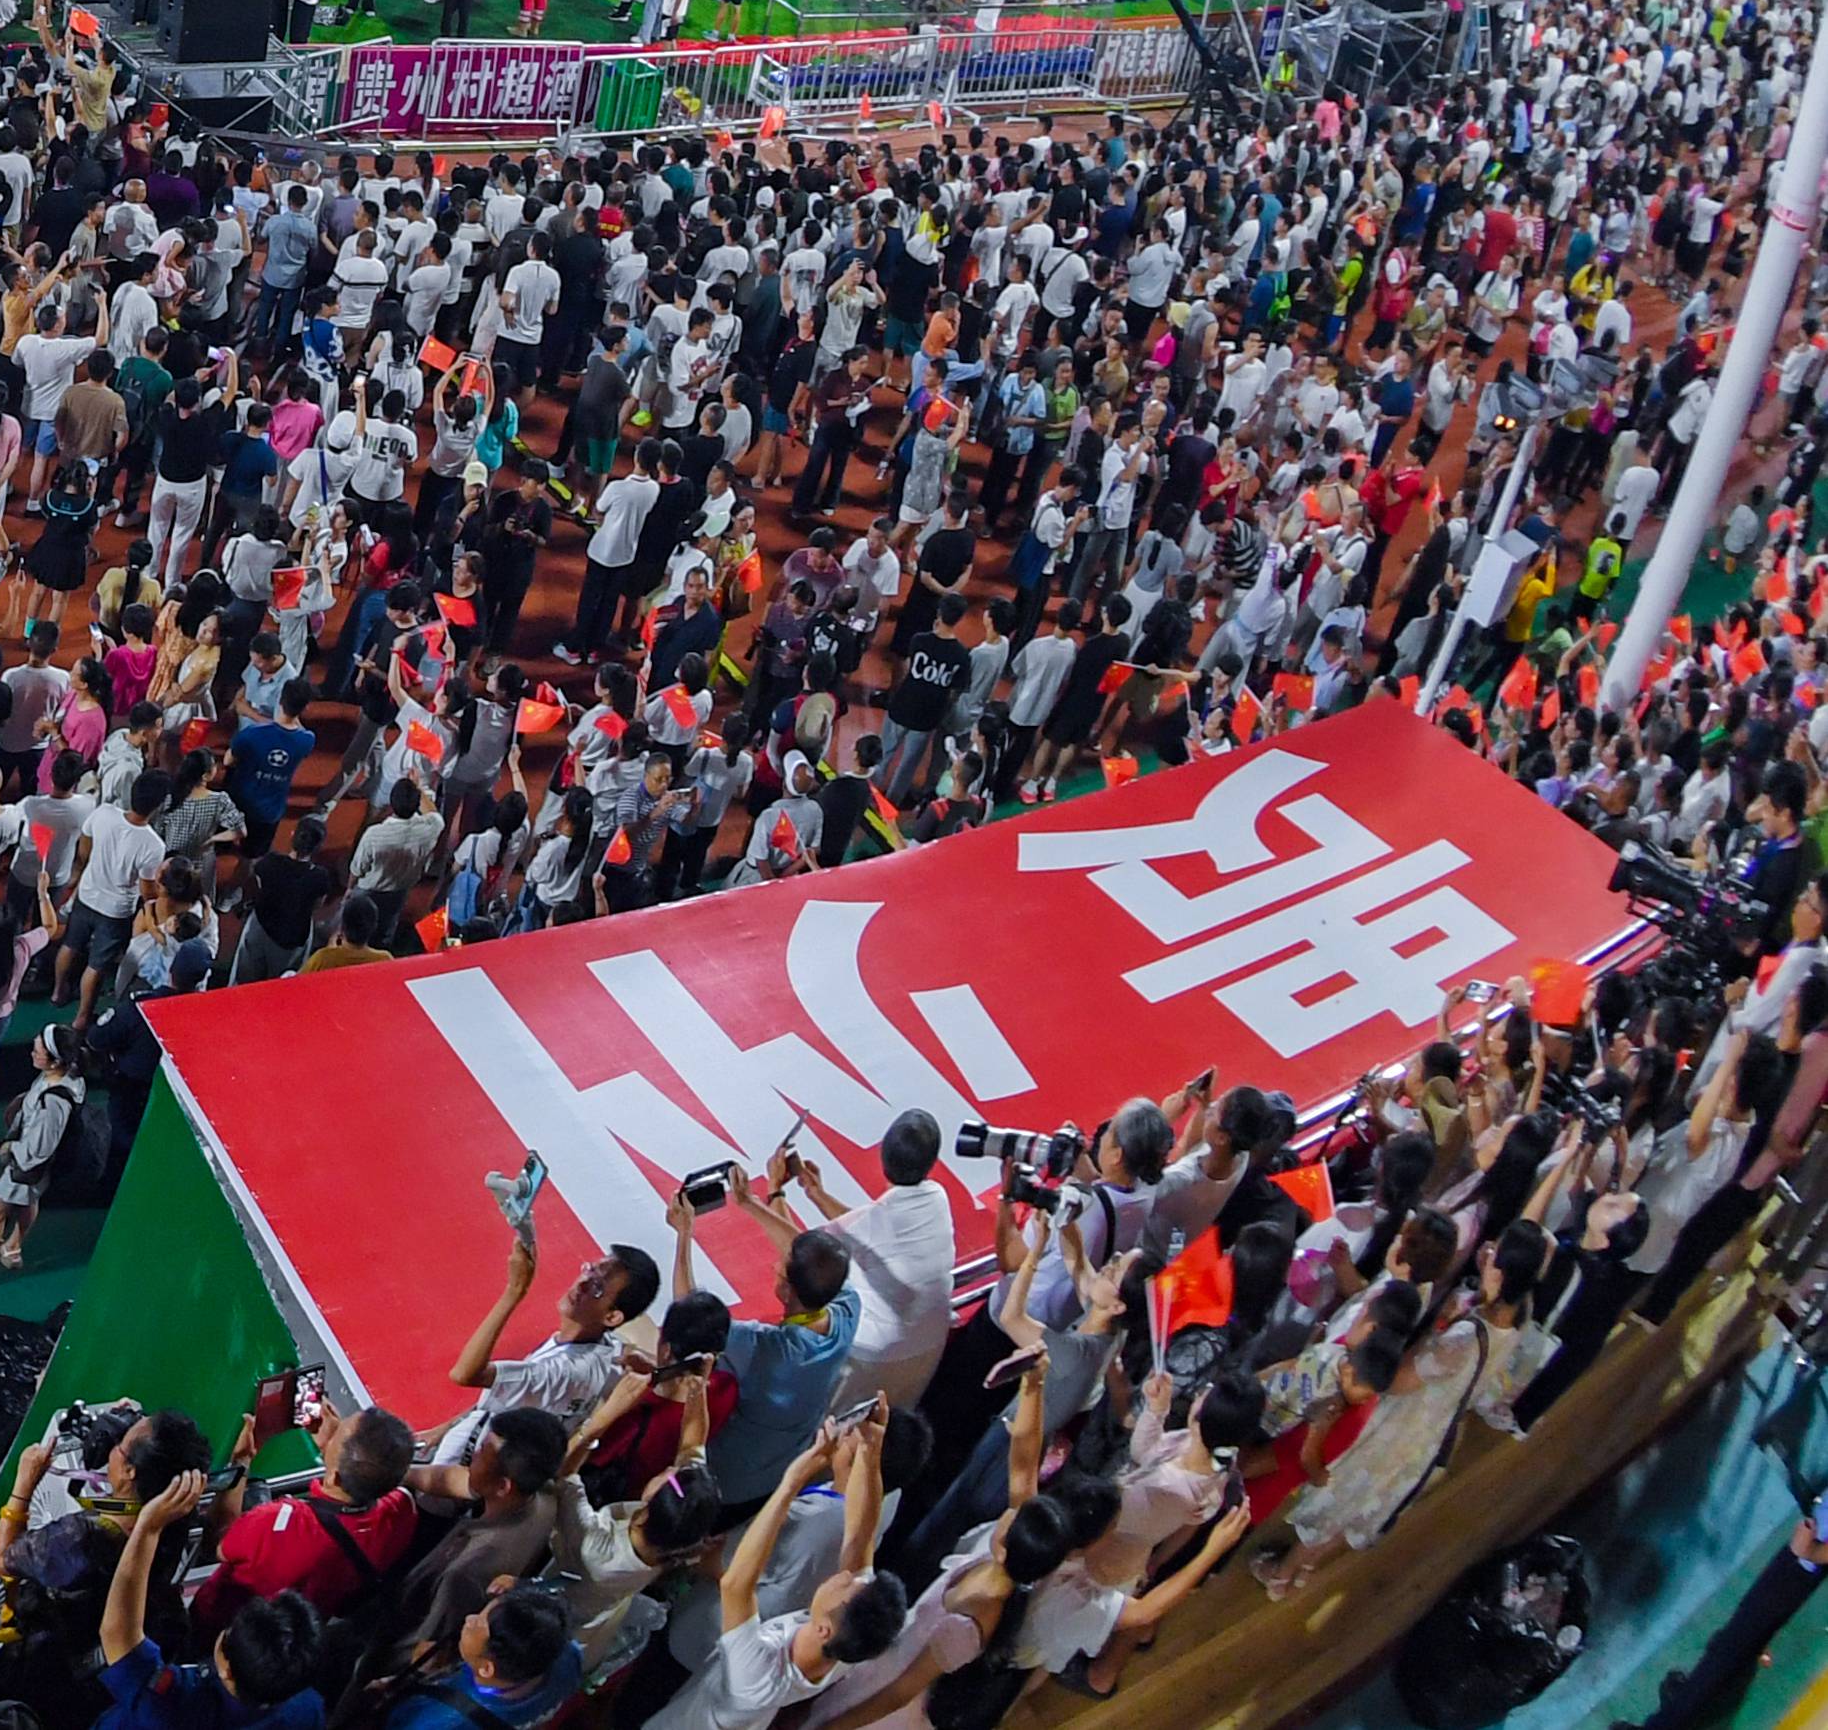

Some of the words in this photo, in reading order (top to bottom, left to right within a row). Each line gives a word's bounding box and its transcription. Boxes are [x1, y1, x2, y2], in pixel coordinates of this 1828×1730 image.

[352, 59, 599, 119] 贵州村超酒
